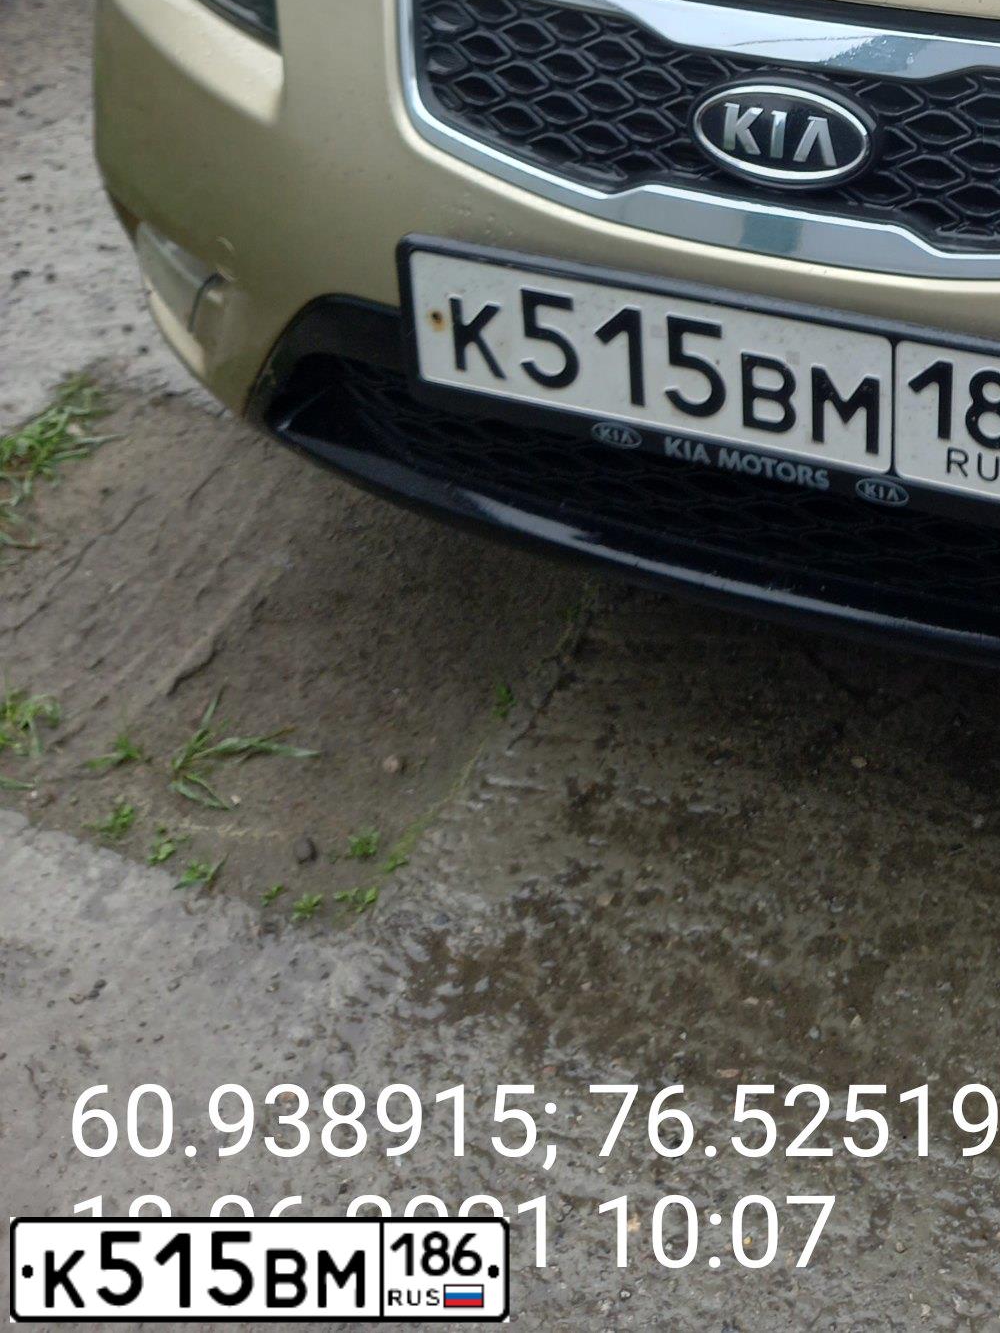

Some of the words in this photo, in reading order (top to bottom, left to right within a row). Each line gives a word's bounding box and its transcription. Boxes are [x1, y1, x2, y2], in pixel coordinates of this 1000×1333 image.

[722, 102, 838, 167] KIA
[664, 436, 711, 466] KIA
[717, 448, 830, 491] MOTORS
